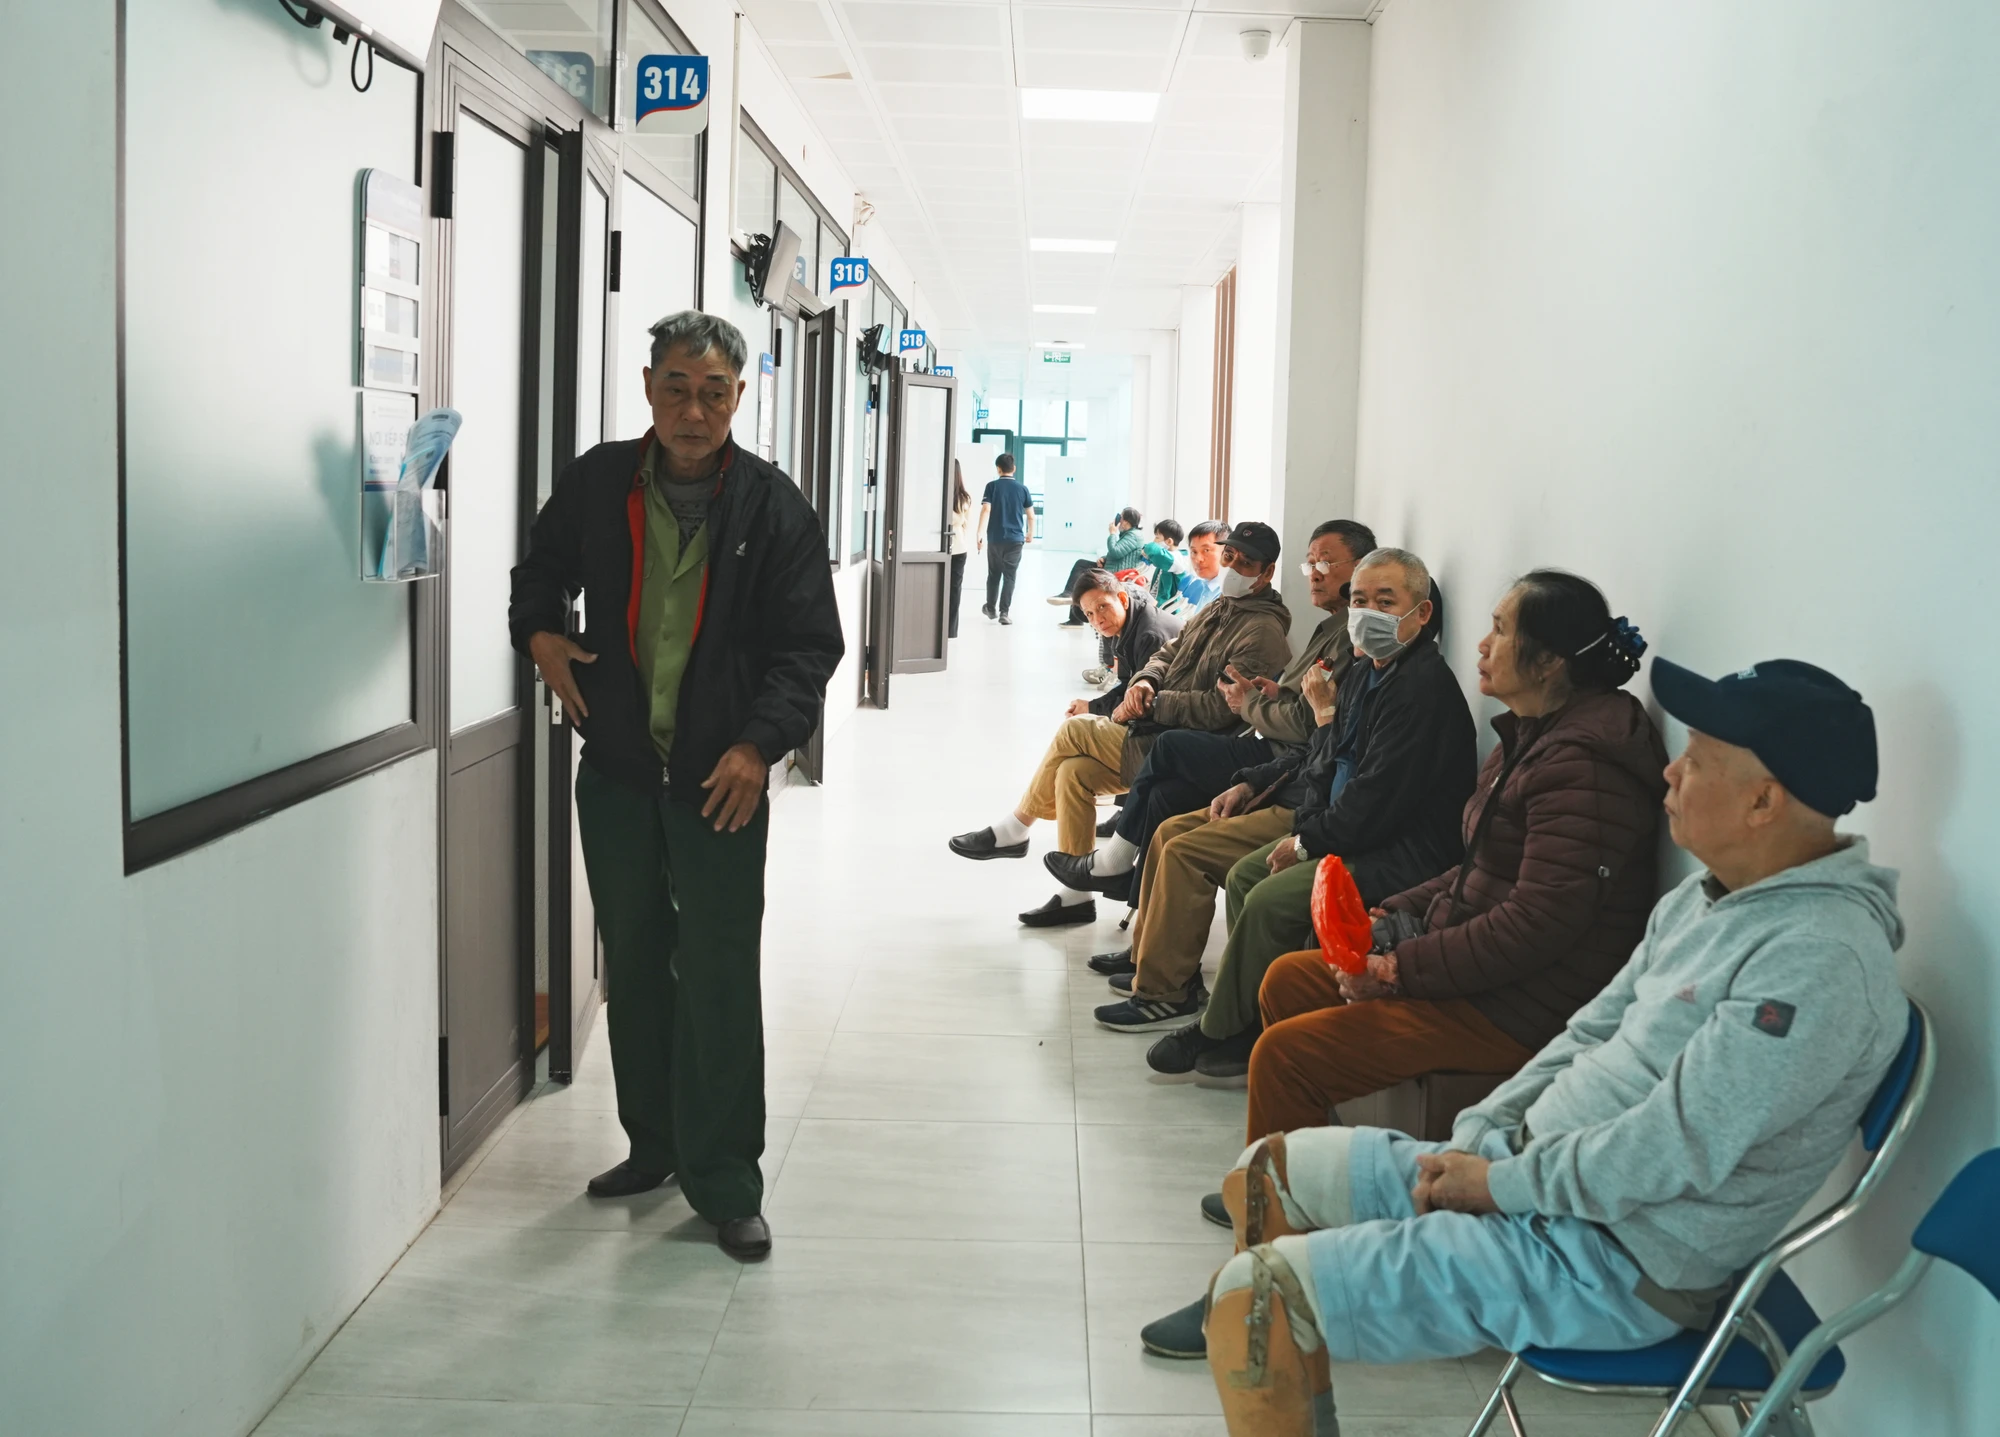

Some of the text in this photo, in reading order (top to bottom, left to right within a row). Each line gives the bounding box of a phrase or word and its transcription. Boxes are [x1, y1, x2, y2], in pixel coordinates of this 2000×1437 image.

[644, 66, 700, 100] 314
[834, 263, 865, 283] 316
[902, 333, 923, 346] 318
